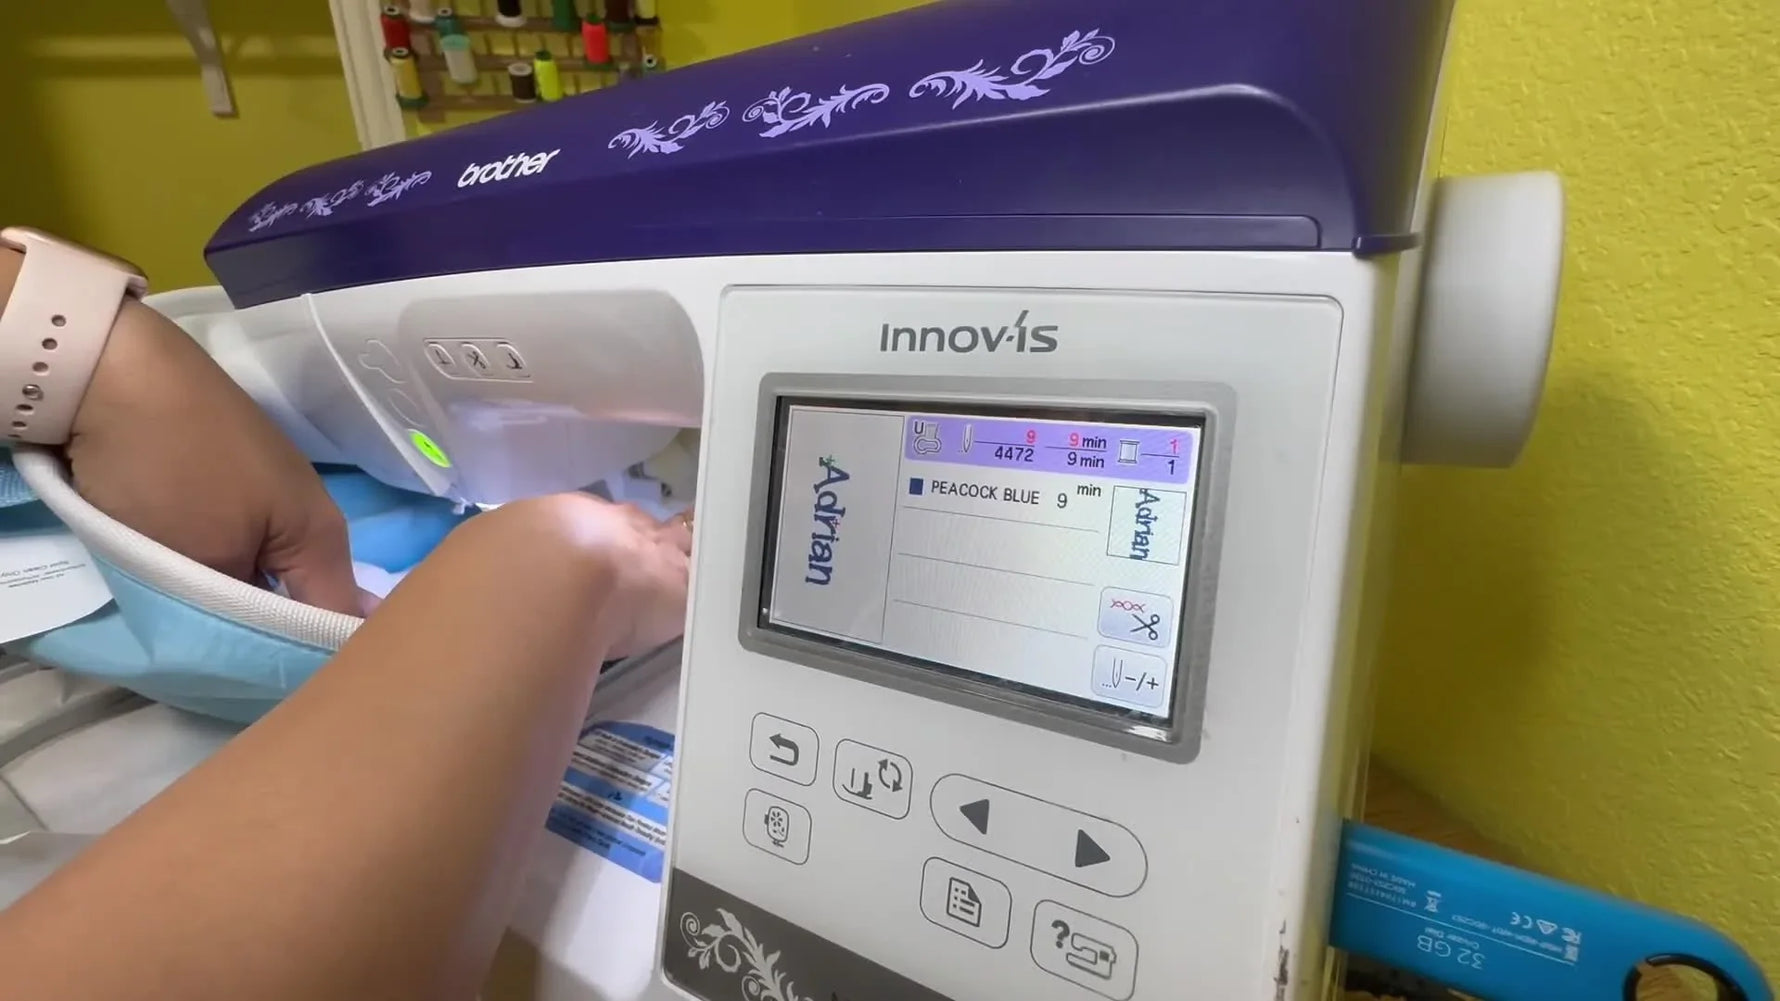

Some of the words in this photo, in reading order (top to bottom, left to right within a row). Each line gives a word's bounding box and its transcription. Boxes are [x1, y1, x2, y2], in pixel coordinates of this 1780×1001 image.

[457, 149, 561, 188] brother
[914, 422, 924, 435] U
[1026, 430, 1036, 444] 9
[1069, 432, 1079, 447] 9
[1082, 434, 1107, 449] min
[1169, 438, 1178, 454] 1
[994, 446, 1034, 463] 4472
[1067, 451, 1078, 466] 9
[1080, 454, 1105, 468] min
[1167, 459, 1175, 475] 1
[931, 479, 998, 501] PEACOCK
[1003, 489, 1040, 505] BLUE
[1057, 493, 1068, 508] 9
[1077, 483, 1101, 497] min
[805, 457, 850, 585] Adrian
[1129, 488, 1161, 561] Adrian
[1417, 935, 1451, 957] GB
[1456, 947, 1486, 970] 32
